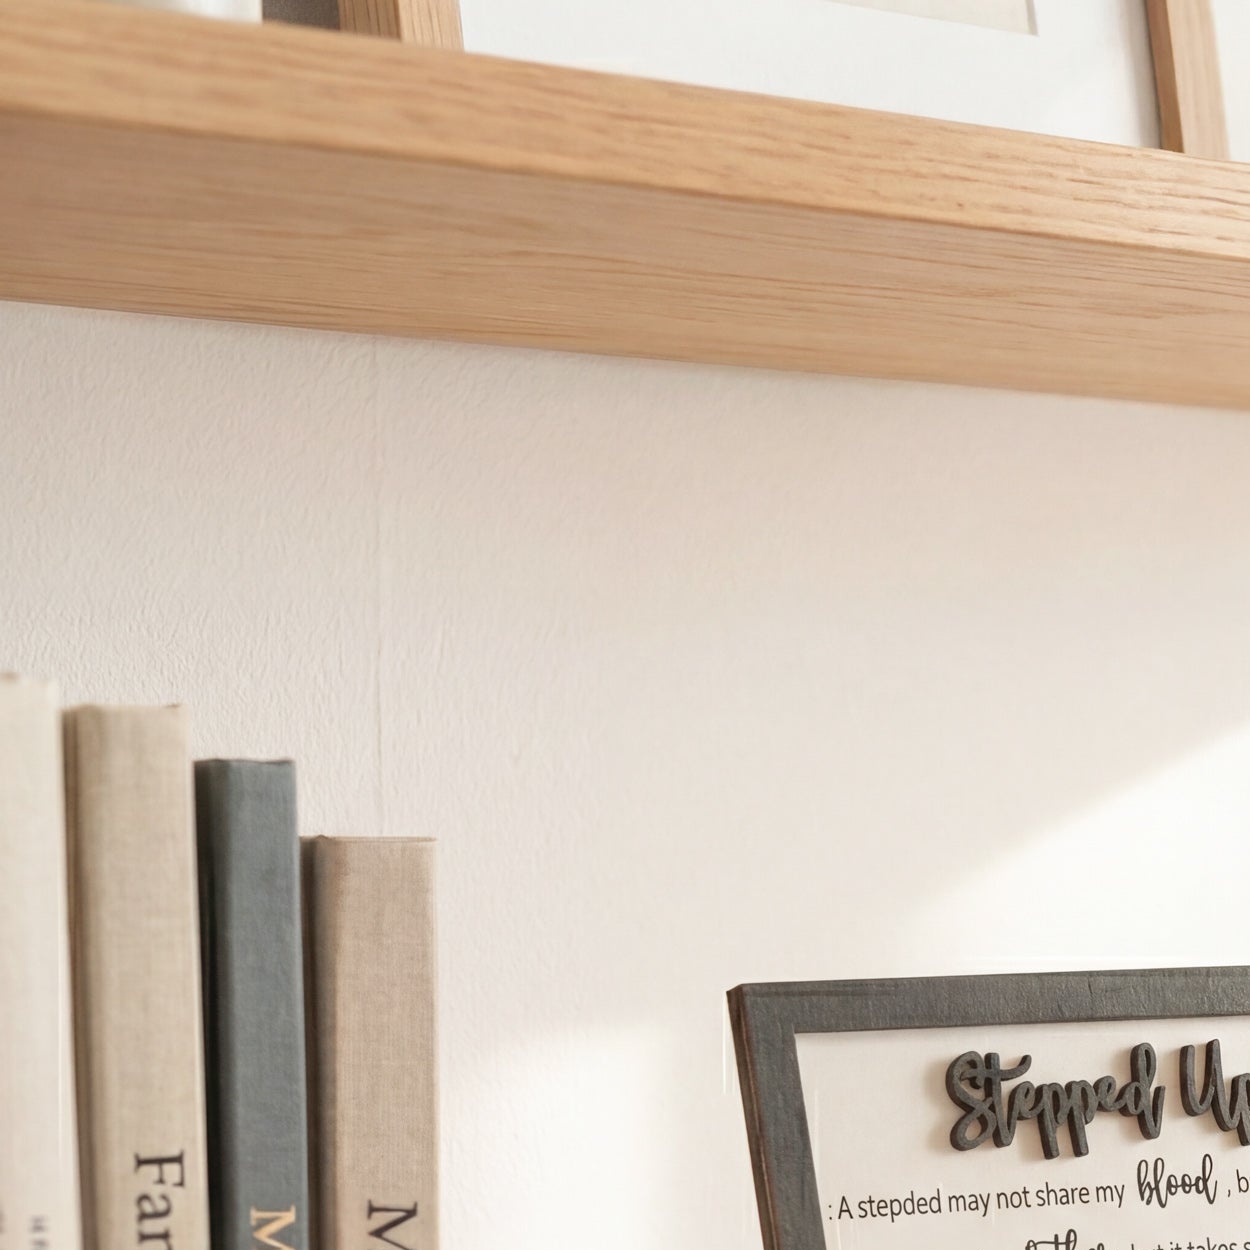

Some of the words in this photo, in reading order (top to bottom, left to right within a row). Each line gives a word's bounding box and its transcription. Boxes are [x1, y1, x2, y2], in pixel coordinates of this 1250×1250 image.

[944, 1042, 1165, 1160] Stepped
[837, 1195, 854, 1220] A
[857, 1188, 942, 1223] stepded
[948, 1192, 991, 1218] may
[996, 1186, 1032, 1210] not
[1035, 1181, 1090, 1207] share
[1095, 1184, 1126, 1209] my
